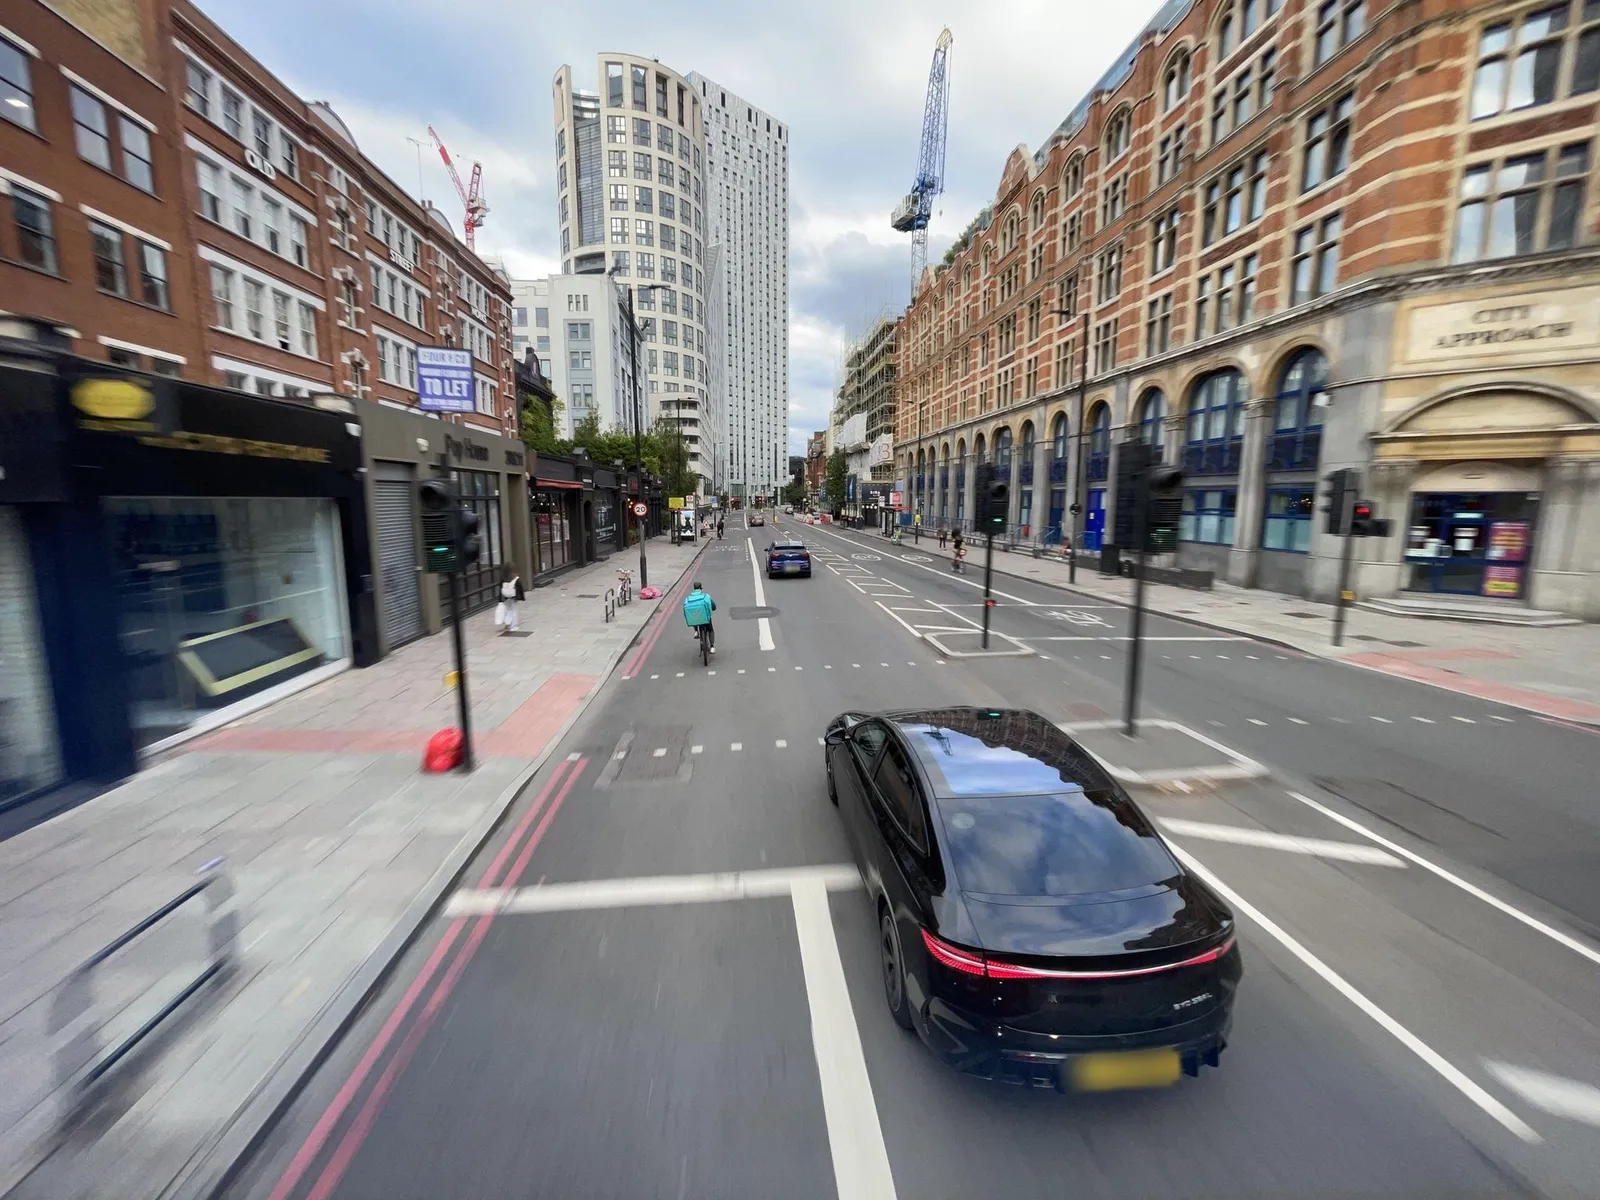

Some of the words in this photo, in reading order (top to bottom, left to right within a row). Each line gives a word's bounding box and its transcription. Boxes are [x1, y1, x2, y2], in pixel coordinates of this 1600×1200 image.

[244, 149, 277, 180] OLD
[390, 249, 415, 275] STREET
[1473, 304, 1534, 325] CITY
[1434, 321, 1574, 348] APPROACH
[422, 376, 443, 396] TO
[443, 378, 469, 398] LET
